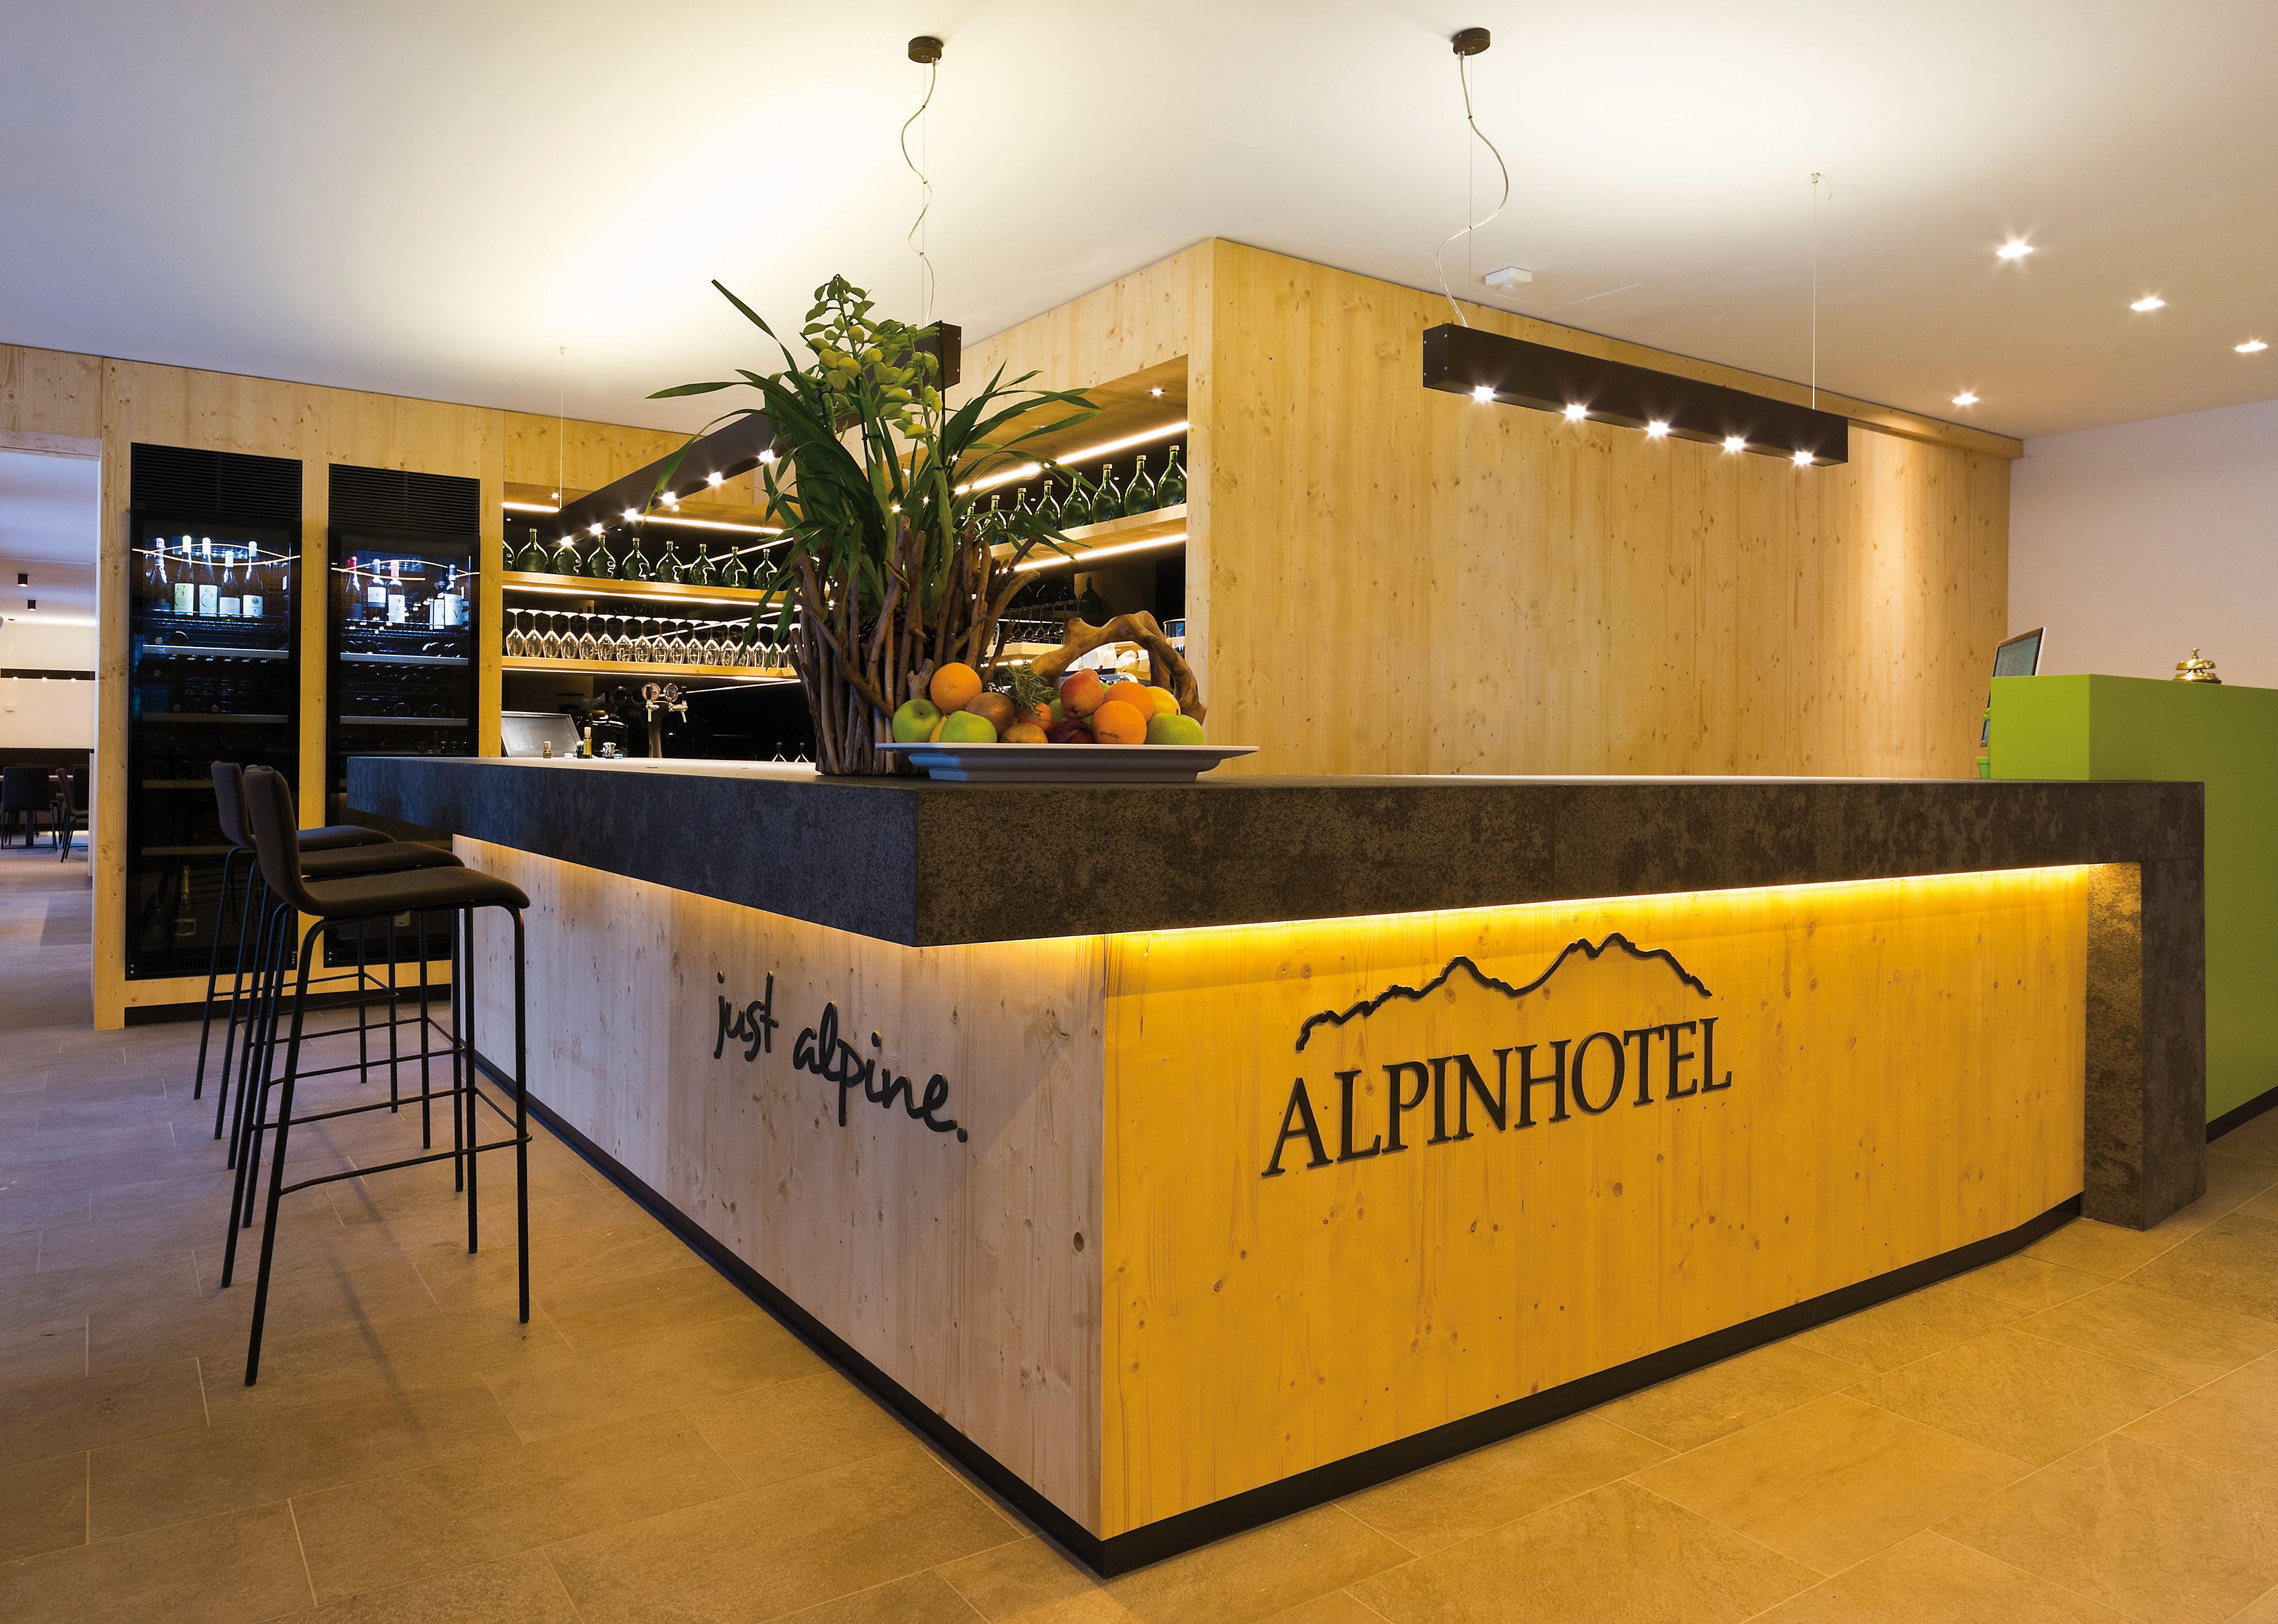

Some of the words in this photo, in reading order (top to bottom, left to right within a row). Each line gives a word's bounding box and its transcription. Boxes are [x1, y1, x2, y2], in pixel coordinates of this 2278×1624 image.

[713, 971, 779, 1062] just
[792, 1001, 968, 1143] alpine.
[1261, 1016, 1732, 1177] ALPINHOTEL
